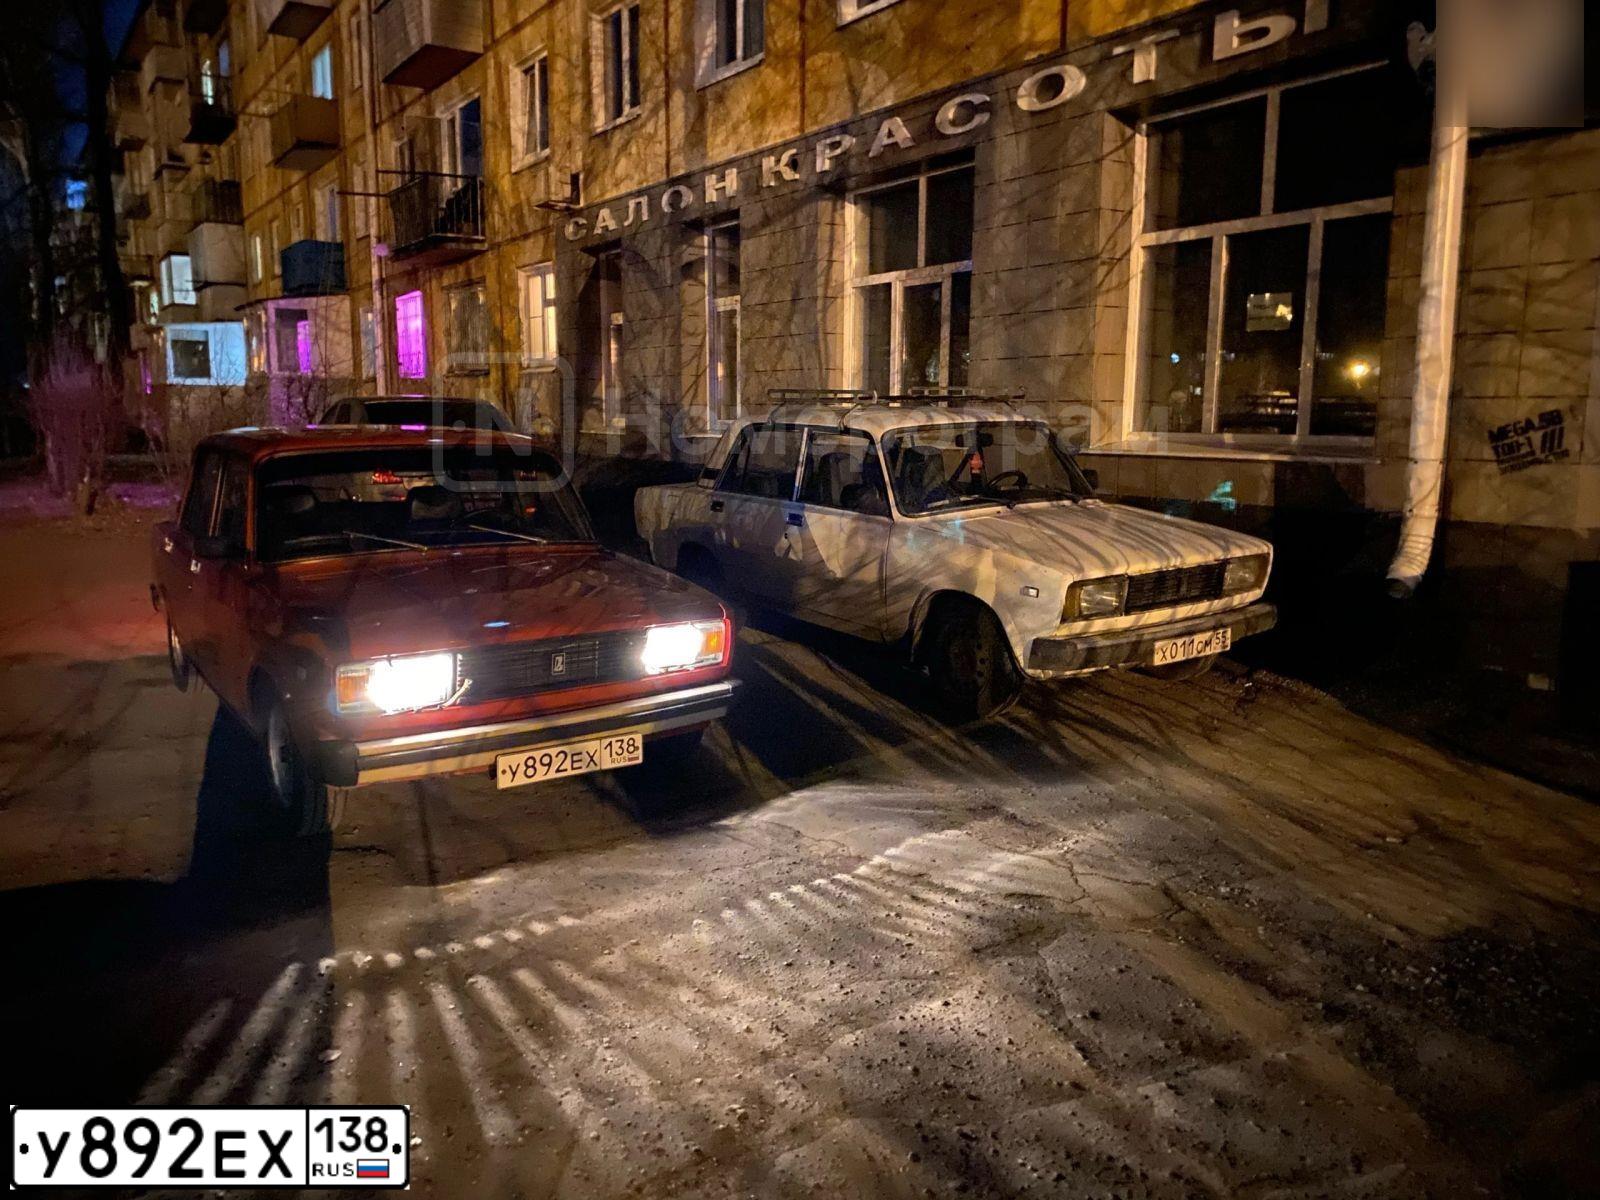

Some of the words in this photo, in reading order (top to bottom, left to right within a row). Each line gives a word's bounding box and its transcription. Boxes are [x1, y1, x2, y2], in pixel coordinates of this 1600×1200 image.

[564, 167, 738, 241] САЛОН
[761, 0, 1329, 188] КРАСОТЫ
[1160, 637, 1213, 662] Х011СМ
[1215, 631, 1227, 645] 55
[508, 749, 598, 783] У892ЕХ
[604, 737, 636, 759] 138
[610, 756, 627, 764] RUS
